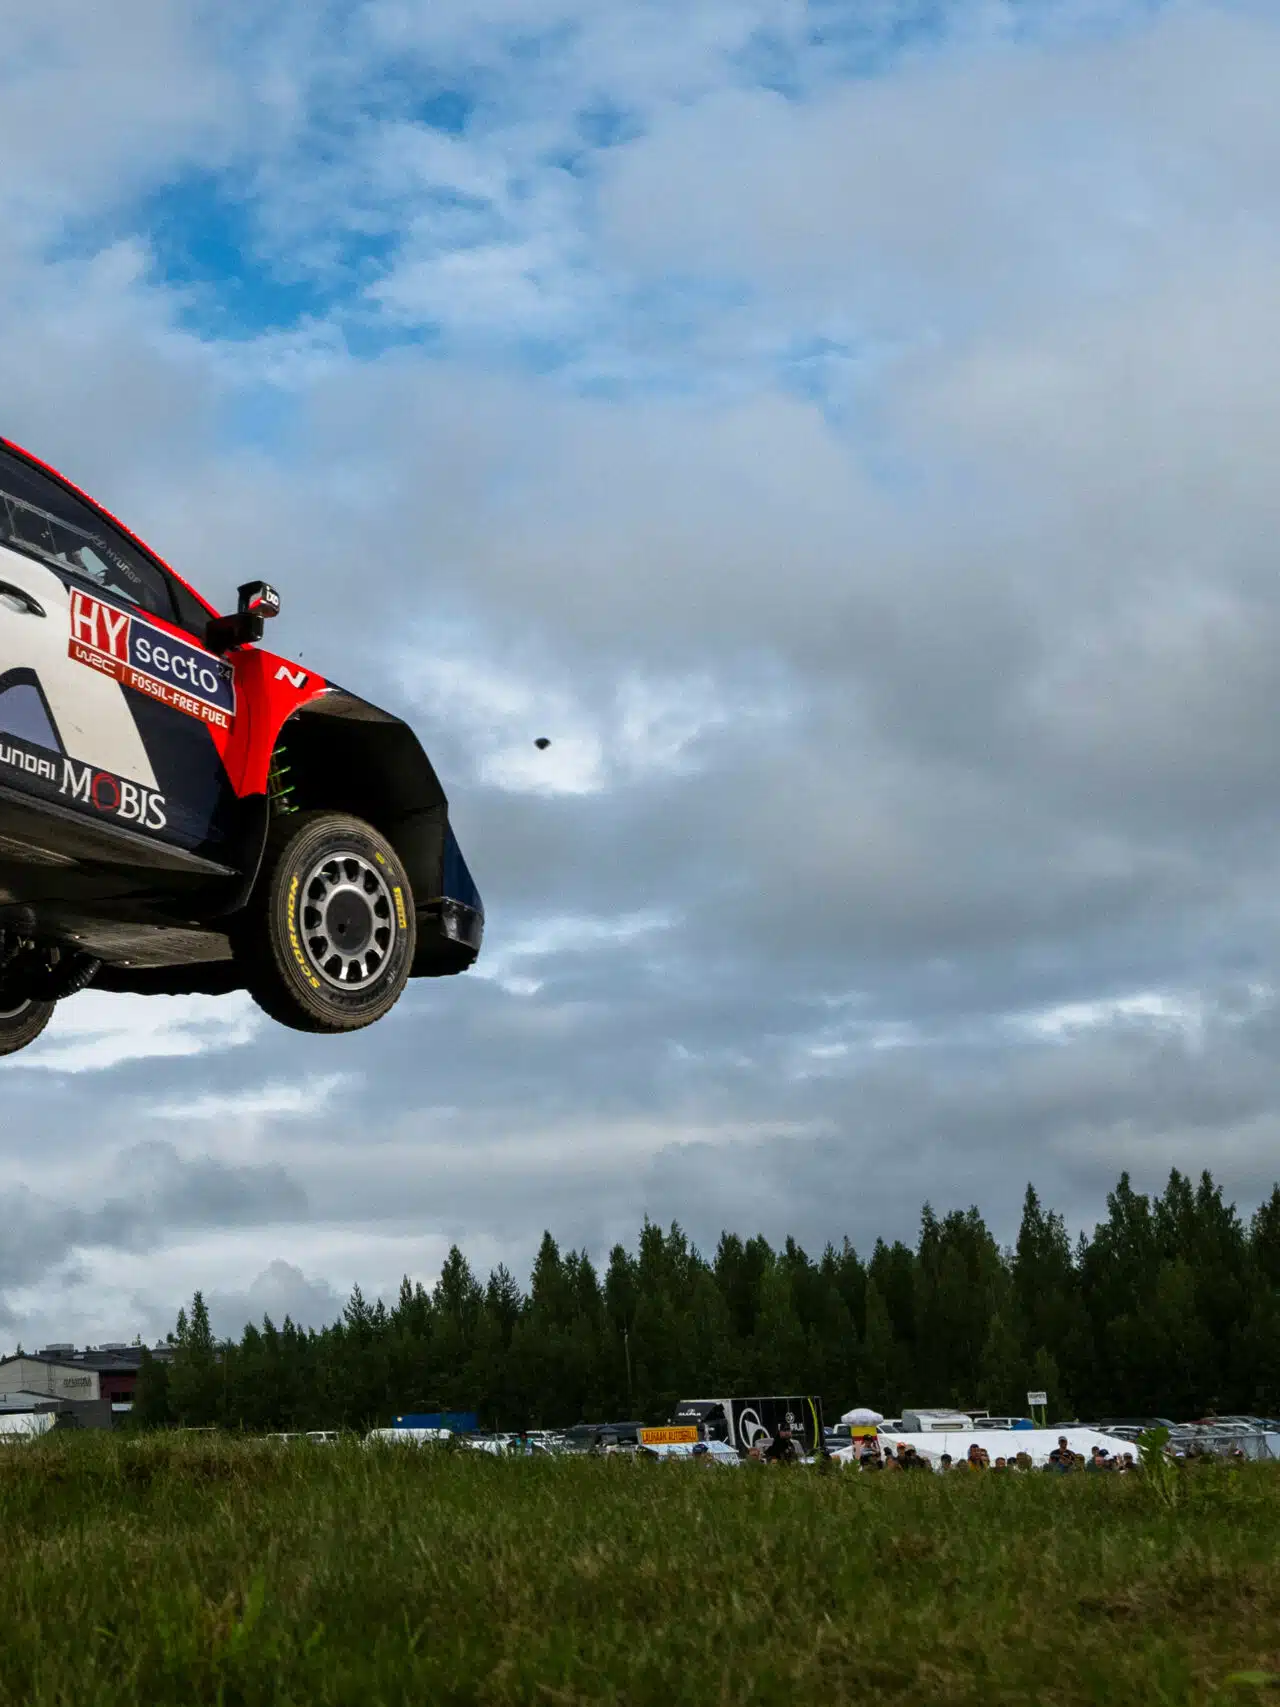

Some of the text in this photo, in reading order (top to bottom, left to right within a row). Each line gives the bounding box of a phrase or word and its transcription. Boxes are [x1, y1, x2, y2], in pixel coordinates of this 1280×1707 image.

[72, 590, 130, 663] HY
[75, 645, 116, 675] WRC
[134, 635, 219, 694] secto
[131, 672, 229, 729] FOSSIL-FREE FUEL
[58, 755, 168, 831] MOBIS
[286, 873, 321, 990] SCORPION
